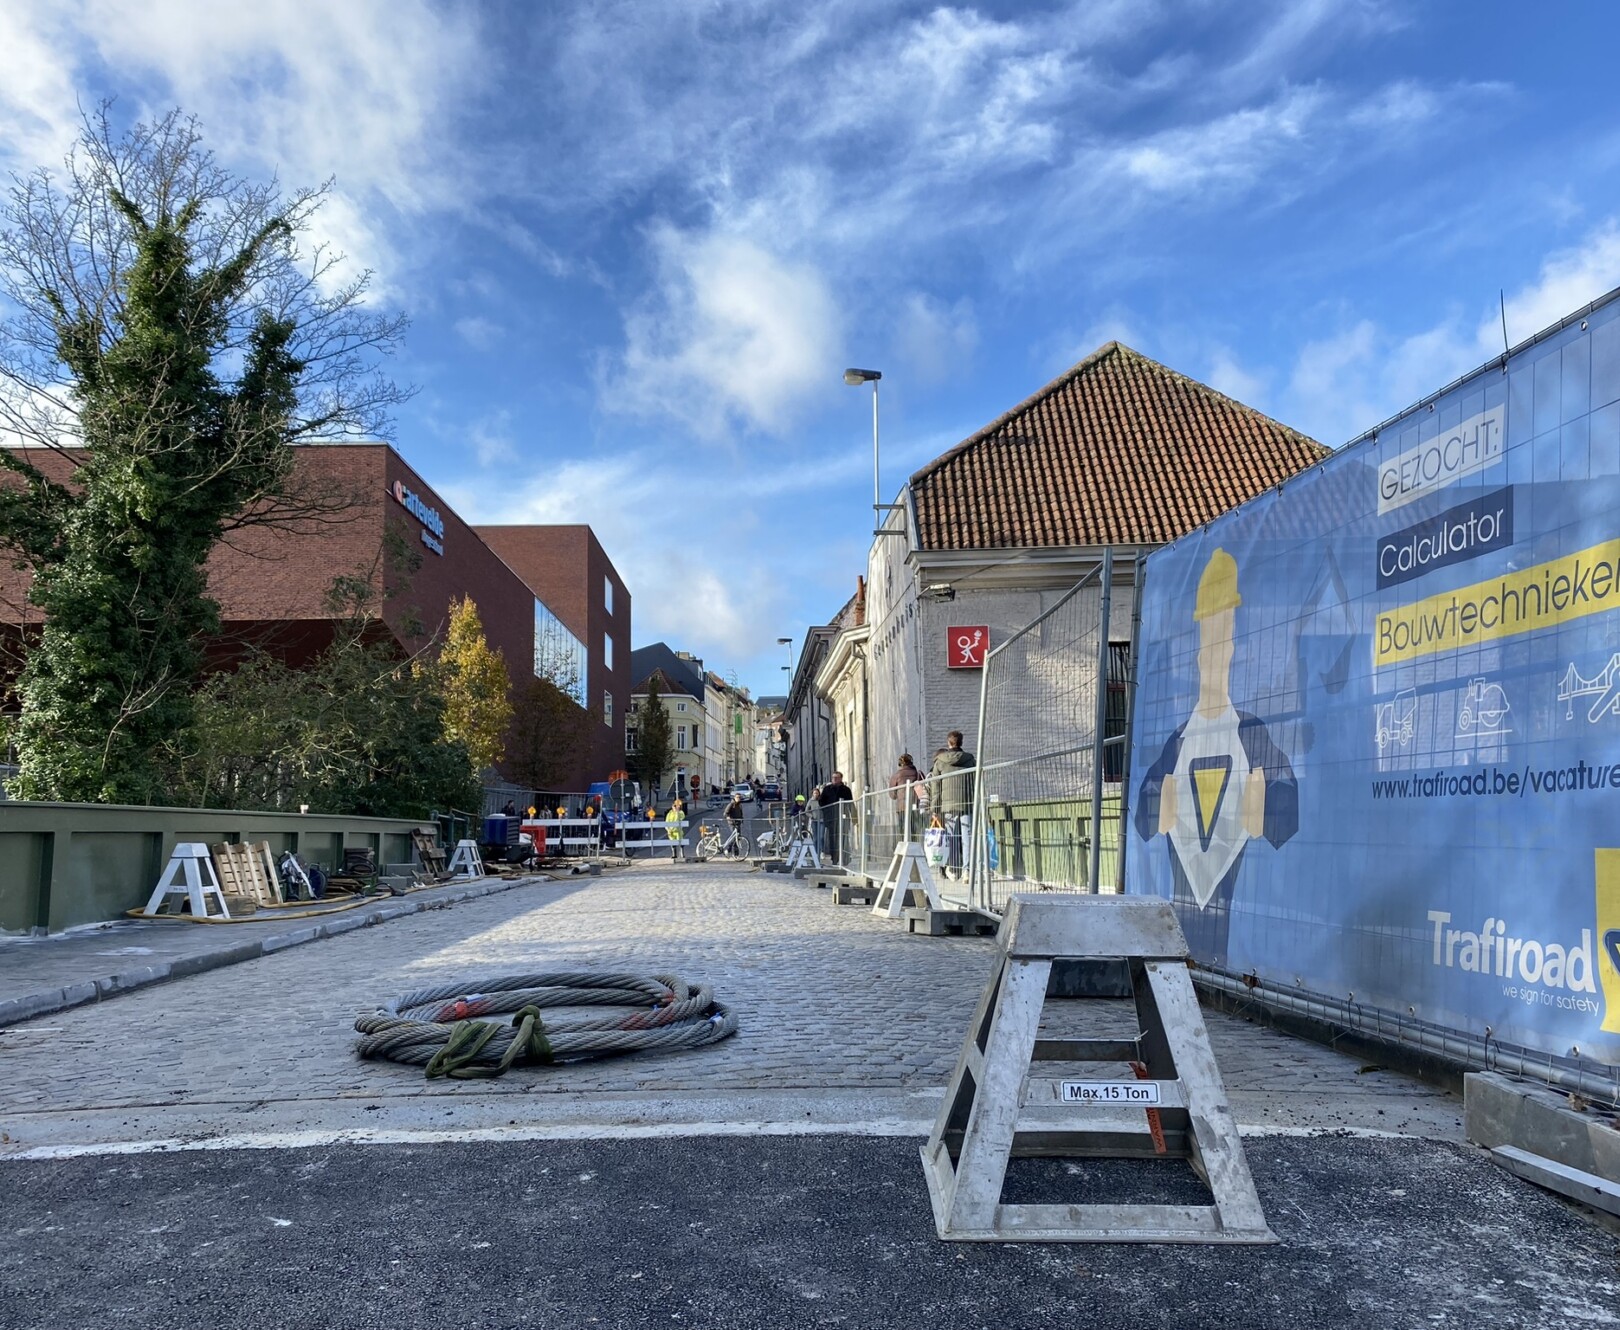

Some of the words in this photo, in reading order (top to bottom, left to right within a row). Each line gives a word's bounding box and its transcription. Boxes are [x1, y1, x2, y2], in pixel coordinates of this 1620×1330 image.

[1380, 419, 1499, 500] GEZOCHT:
[1379, 508, 1504, 577] Calculator
[1371, 760, 1620, 799] www.trafiroad.be/vacature
[1427, 910, 1597, 993] Trafiroad
[1502, 985, 1517, 998] we
[1519, 986, 1539, 1005] sign
[1540, 989, 1554, 1006] for
[1556, 995, 1599, 1017] safety
[1123, 1086, 1149, 1099] Ton
